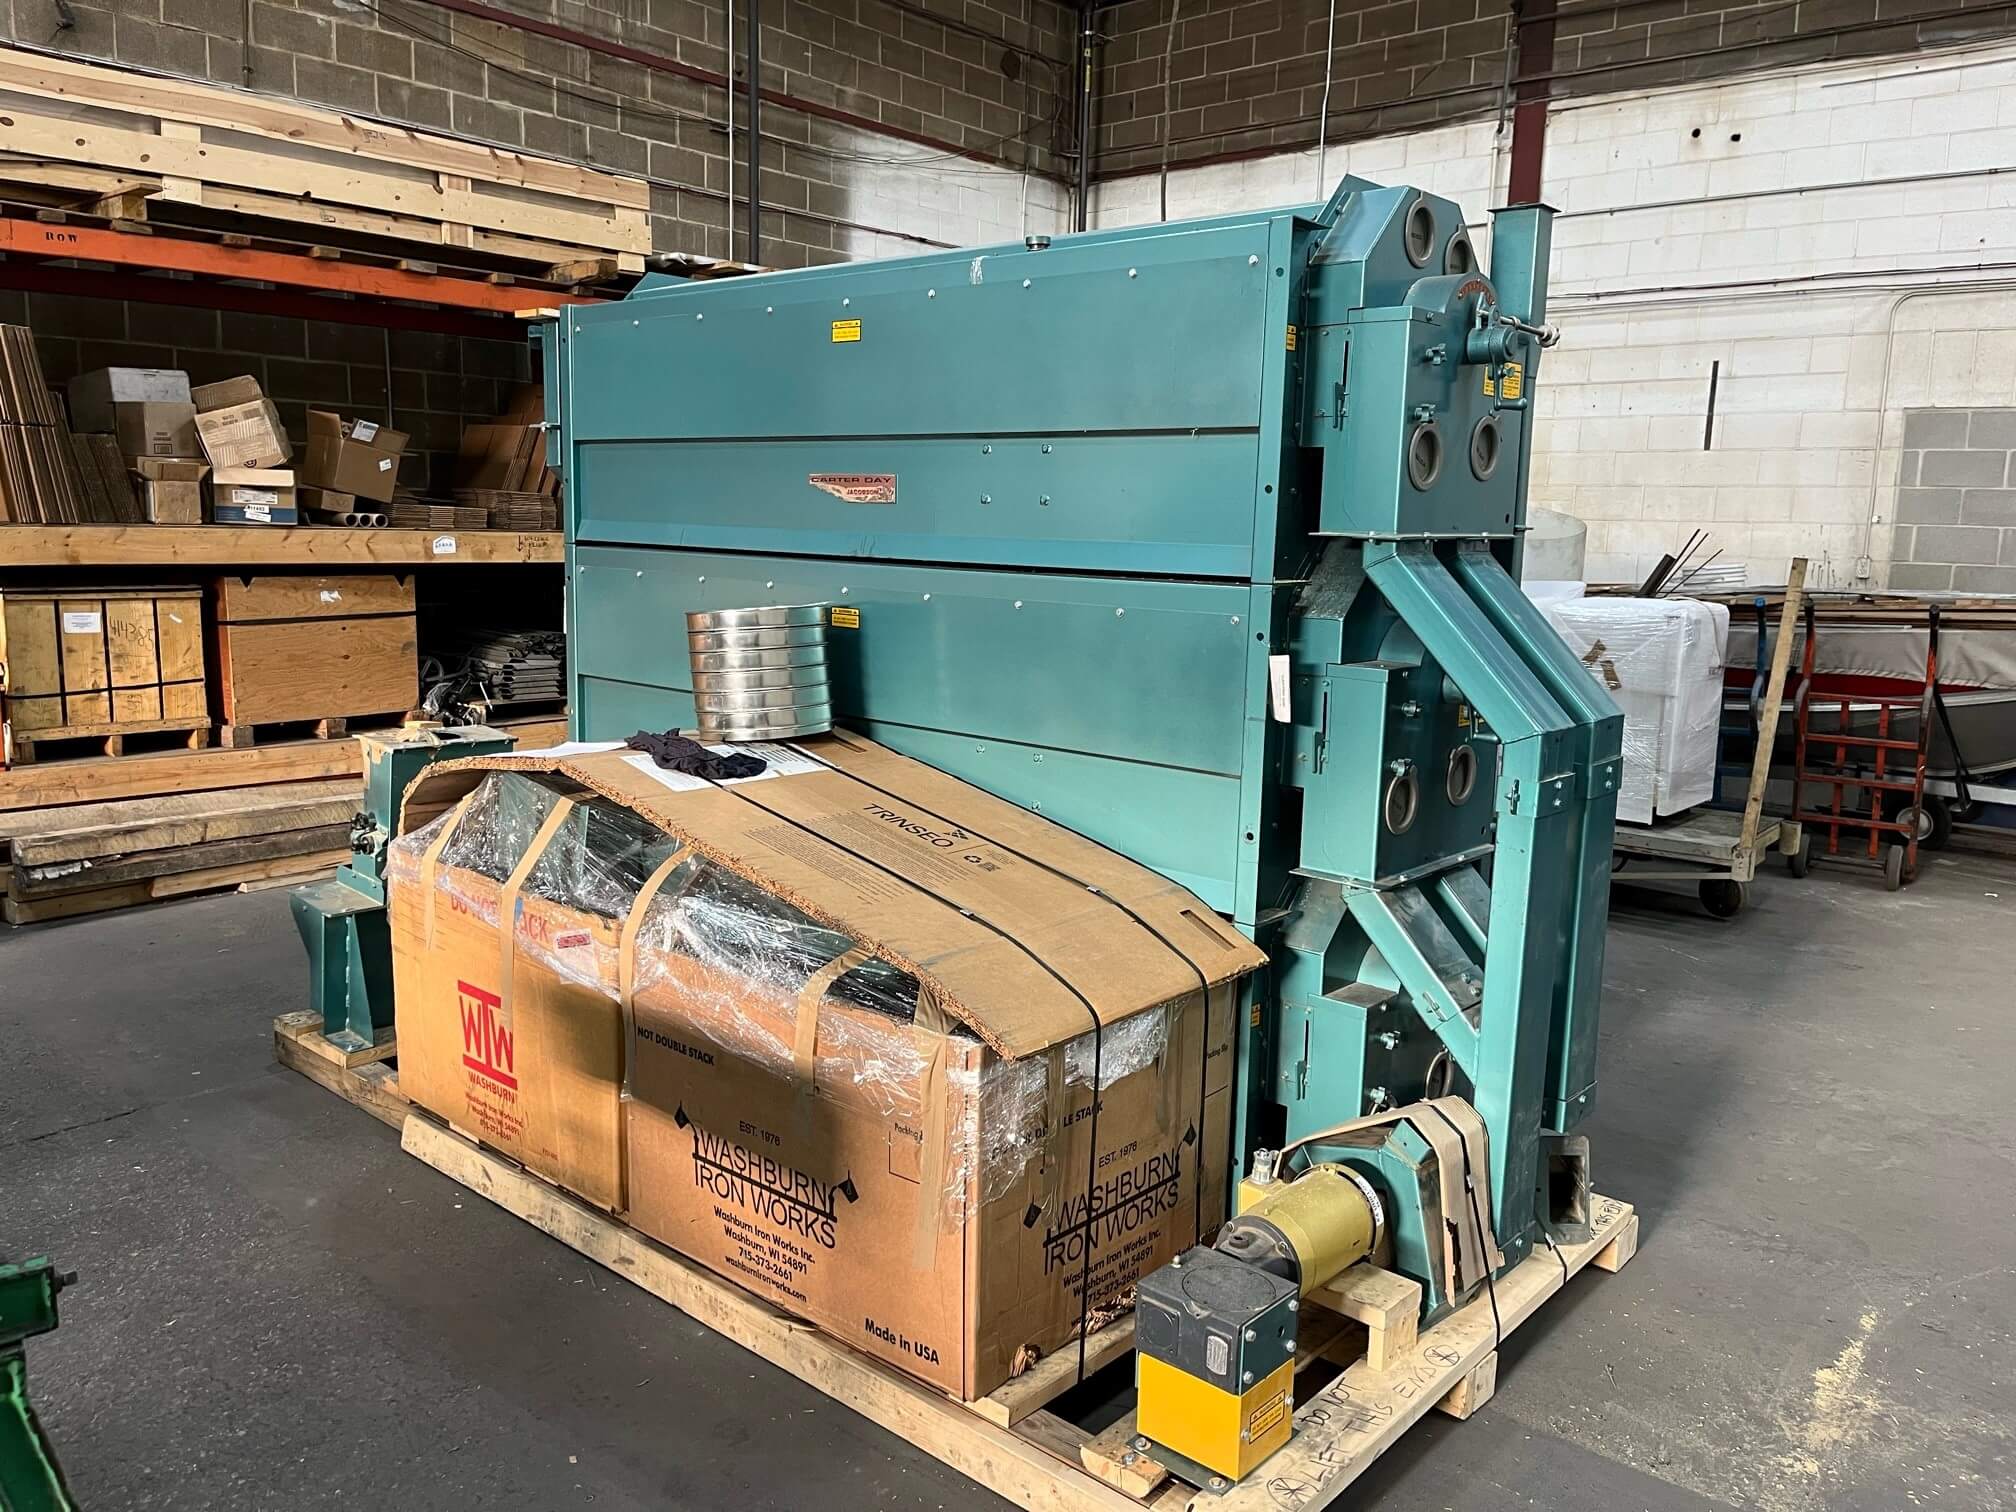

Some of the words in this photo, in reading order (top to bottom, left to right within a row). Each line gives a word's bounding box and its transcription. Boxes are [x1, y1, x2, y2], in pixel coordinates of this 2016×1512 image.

[45, 231, 78, 243] ROW
[811, 476, 860, 484] CARTER
[864, 476, 892, 484] DAY
[863, 803, 954, 848] TRINSEO
[637, 1025, 654, 1041] NOT
[655, 1034, 687, 1055] DOUBLE
[688, 1046, 715, 1066] STACK
[467, 1071, 516, 1104] WASHBURN
[739, 1120, 758, 1137] EST.
[700, 1128, 827, 1211] WASHBURN
[1098, 1150, 1117, 1168] EST.
[1119, 1141, 1138, 1159] 1976
[694, 1160, 745, 1208] IRON
[751, 1184, 836, 1249] WORKS
[1058, 1148, 1176, 1231] WASHBURN
[713, 1205, 753, 1233] Washburn
[754, 1225, 771, 1242] Iron
[772, 1233, 799, 1255] Works
[800, 1247, 816, 1264] Inc.
[724, 1224, 767, 1256] Washburn,
[768, 1246, 780, 1261] WI
[782, 1254, 807, 1275] 54891
[1044, 1220, 1099, 1276] IRON
[1105, 1182, 1179, 1242] WORKS
[1106, 1249, 1121, 1264] Iron
[1123, 1235, 1148, 1255] Works
[1148, 1229, 1161, 1242] Inc.
[738, 1246, 793, 1282] 715-373-2661
[1118, 1259, 1130, 1273] WI
[865, 1317, 896, 1345] Made
[900, 1334, 911, 1353] in
[914, 1341, 940, 1366] USA
[1298, 1408, 1332, 1427] DO
[1319, 1376, 1362, 1410] NOT
[1299, 1440, 1350, 1483] LIFT
[1341, 1401, 1394, 1435] THIS
[1392, 1365, 1438, 1400] END
